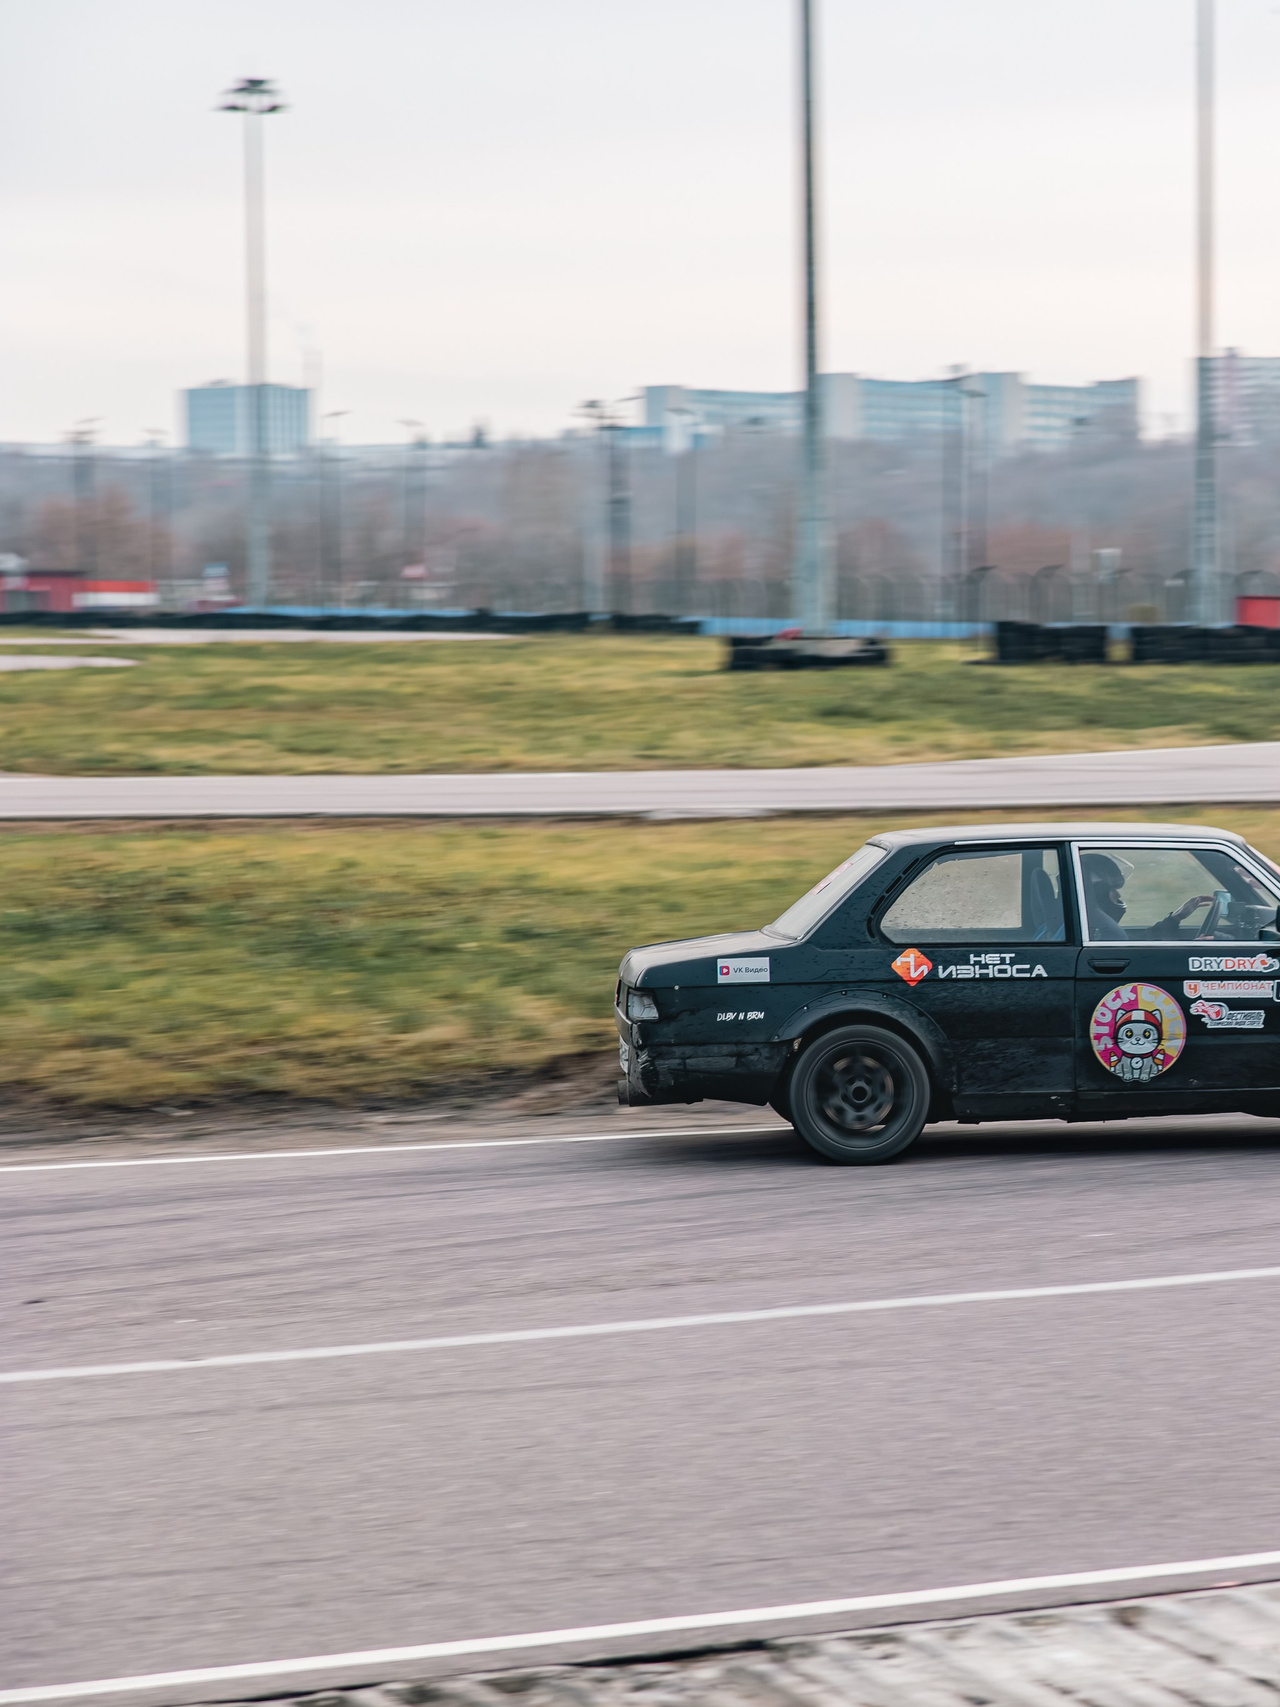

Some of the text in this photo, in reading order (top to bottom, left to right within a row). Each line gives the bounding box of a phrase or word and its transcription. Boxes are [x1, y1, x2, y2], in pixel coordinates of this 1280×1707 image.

[970, 953, 1015, 964] НЕТ
[1191, 959, 1257, 969] DRYDRY
[744, 966, 768, 974] Видео
[938, 964, 1048, 978] ИЗНОСА
[1202, 982, 1272, 991] ЧЕМПИОНАТ
[1093, 985, 1136, 1052] STOCK
